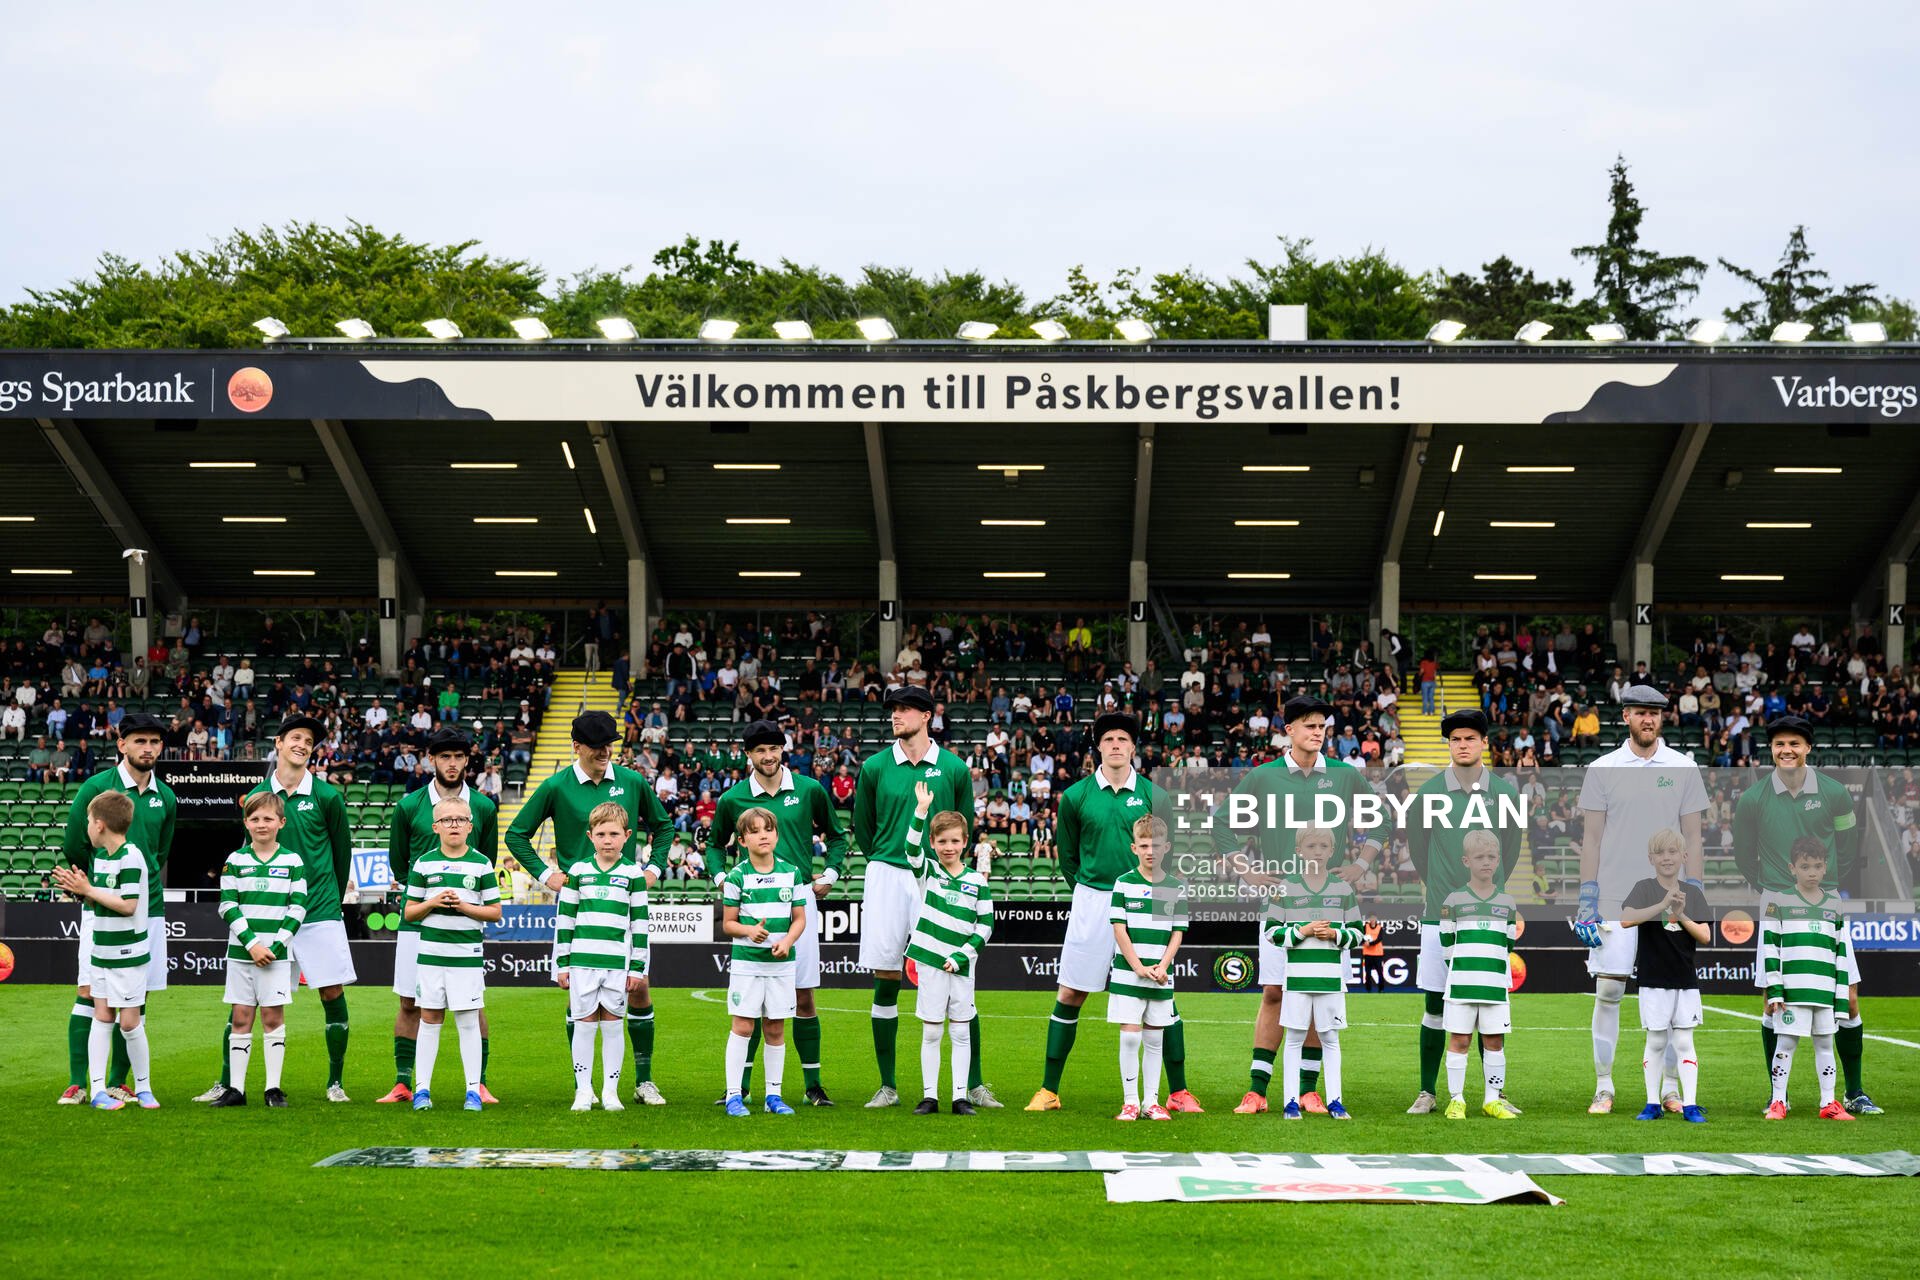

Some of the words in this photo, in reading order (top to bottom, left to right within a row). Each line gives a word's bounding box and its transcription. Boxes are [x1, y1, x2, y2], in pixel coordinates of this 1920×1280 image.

[42, 372, 195, 411] Sparbank
[636, 374, 905, 409] Välkommen
[924, 374, 985, 409] till
[1007, 373, 1400, 419] Påskbergsvallen!
[1772, 376, 1918, 417] Varbergs
[883, 602, 893, 620] J
[1134, 602, 1144, 620] J
[1637, 606, 1650, 624] K
[1890, 606, 1902, 624] K
[165, 773, 264, 785] Sparbanksläktaren
[204, 797, 234, 806] Sparbank
[648, 912, 702, 922] ARBERGS
[1009, 911, 1043, 920] FOND
[1046, 911, 1053, 920] &
[1195, 912, 1237, 921] SEDAN
[648, 924, 696, 933] OMMUN
[1850, 916, 1908, 941] ands
